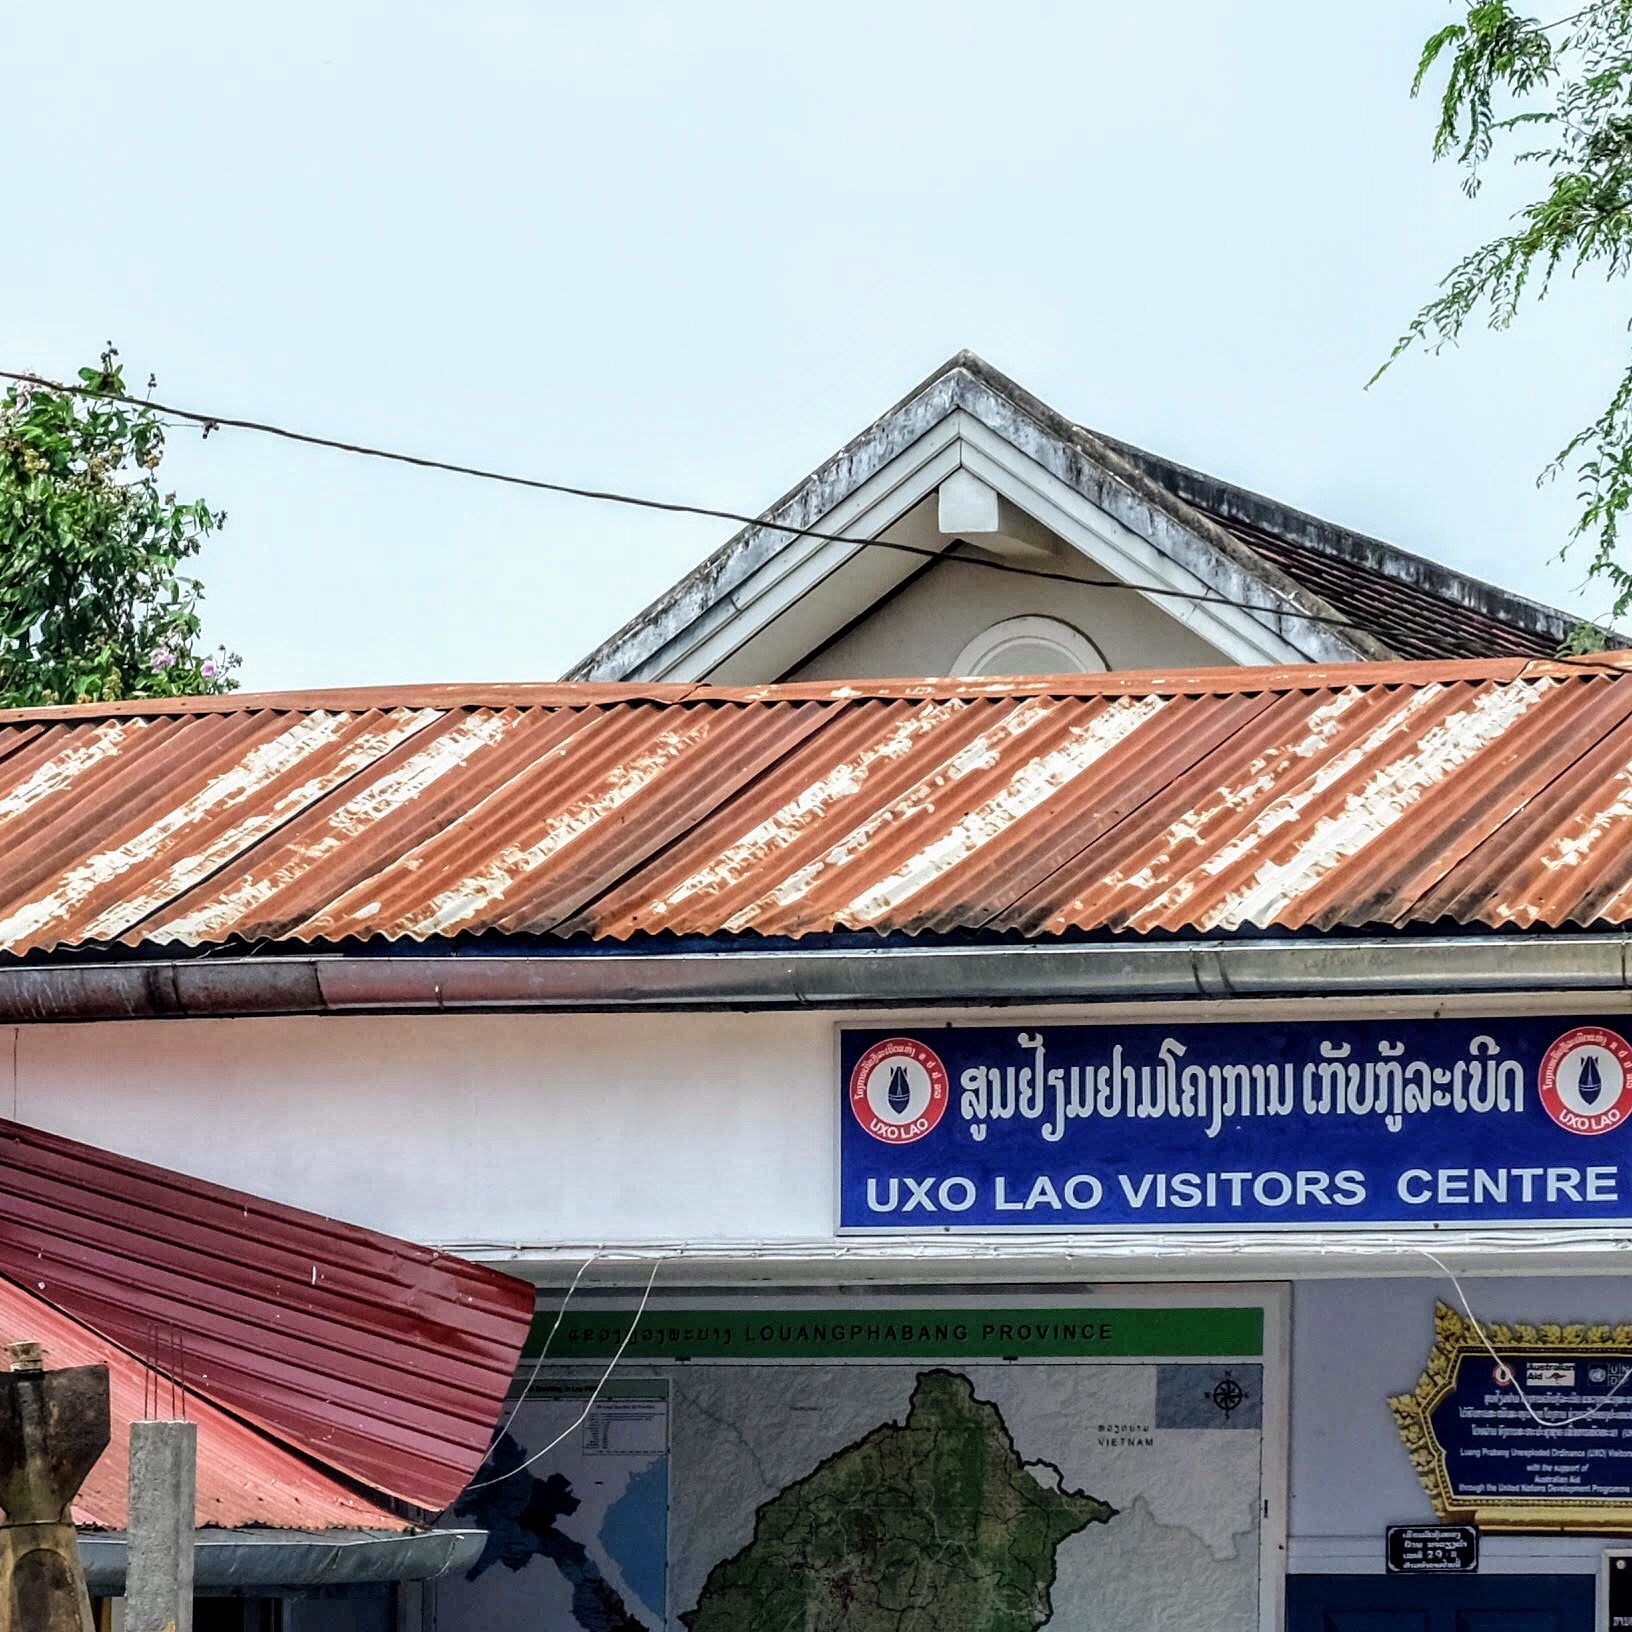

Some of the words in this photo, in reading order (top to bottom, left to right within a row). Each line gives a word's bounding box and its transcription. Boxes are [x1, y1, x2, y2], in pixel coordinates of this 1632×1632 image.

[869, 1118, 898, 1138] UXO
[900, 1118, 928, 1138] LAO
[1559, 1109, 1589, 1129] UXO
[1590, 1109, 1620, 1129] LAO
[866, 1176, 976, 1212] UXO
[995, 1175, 1103, 1211] LAO
[1118, 1170, 1366, 1208] VISITORS
[1397, 1166, 1619, 1204] CENTRE
[745, 1325, 968, 1342] LOUANGPHABANG
[981, 1323, 1113, 1341] PROVINCE
[1097, 1437, 1154, 1449] VIETNAM
